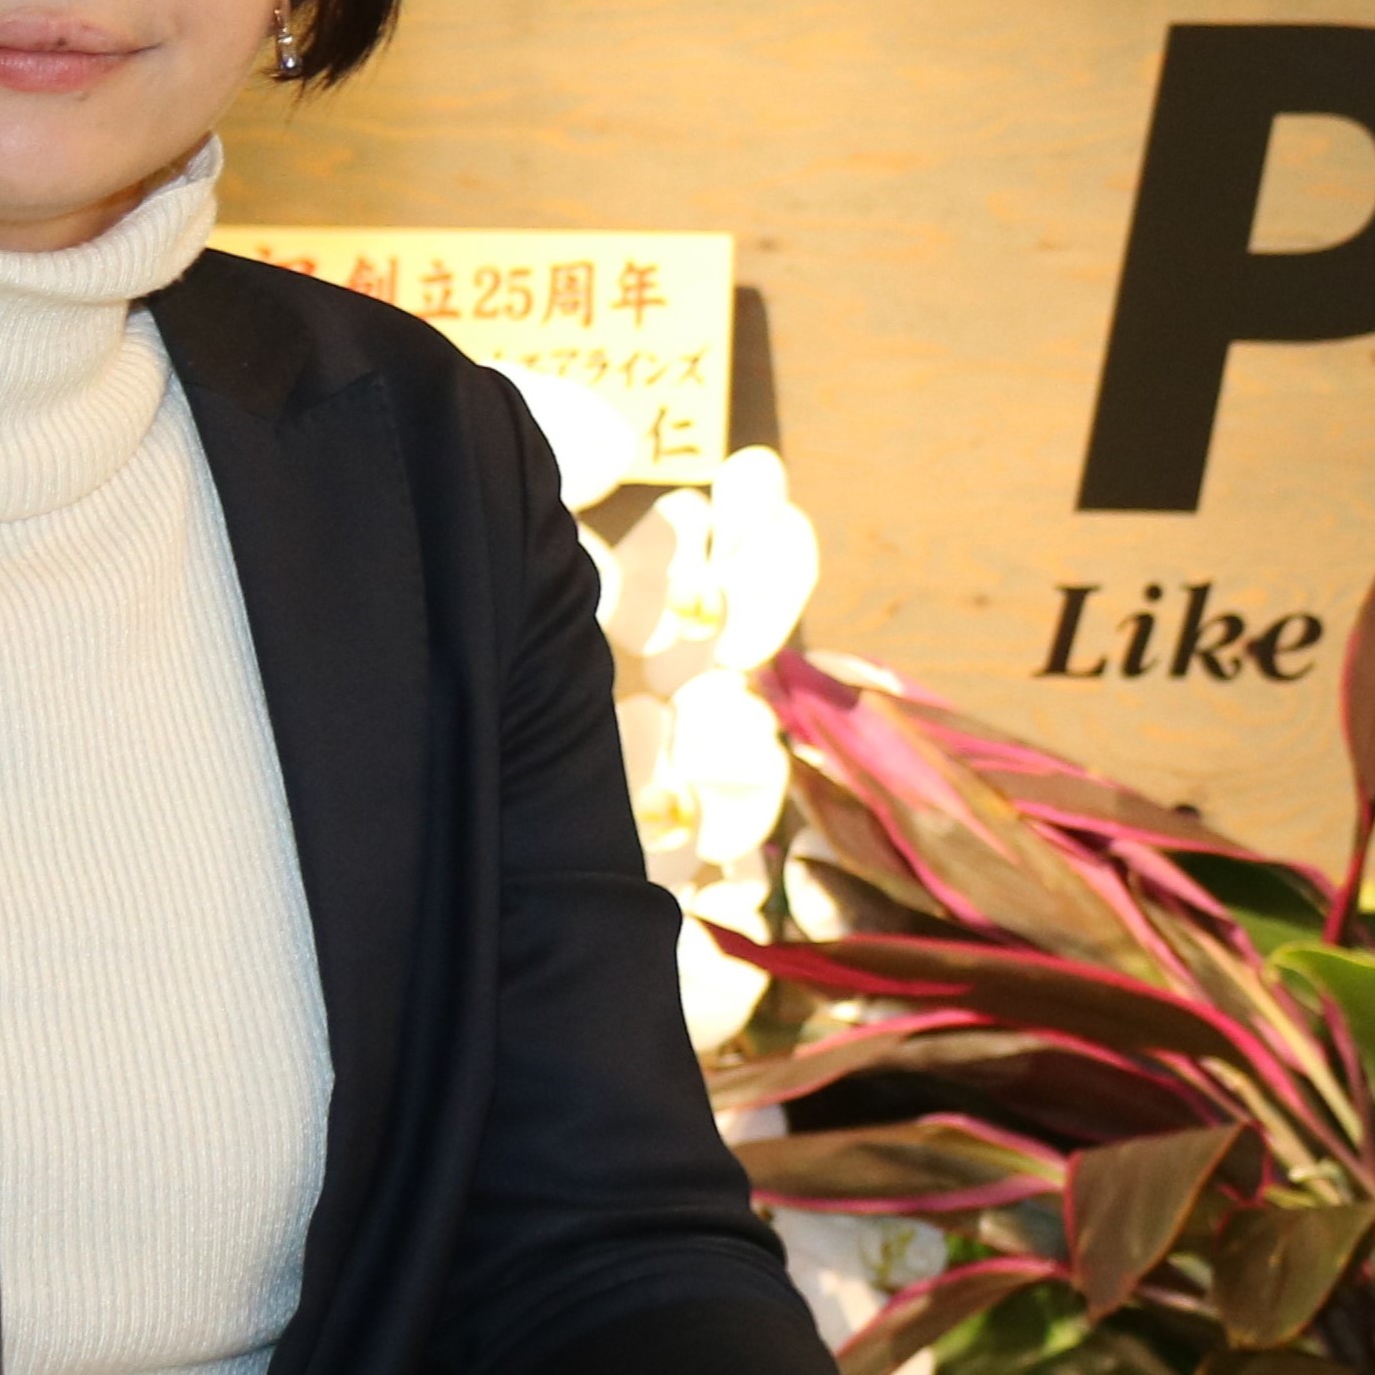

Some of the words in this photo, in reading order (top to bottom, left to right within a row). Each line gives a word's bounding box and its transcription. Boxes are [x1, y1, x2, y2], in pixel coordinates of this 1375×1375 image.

[1075, 22, 1375, 512] P
[646, 407, 699, 462] 仁
[1032, 580, 1323, 682] Like
